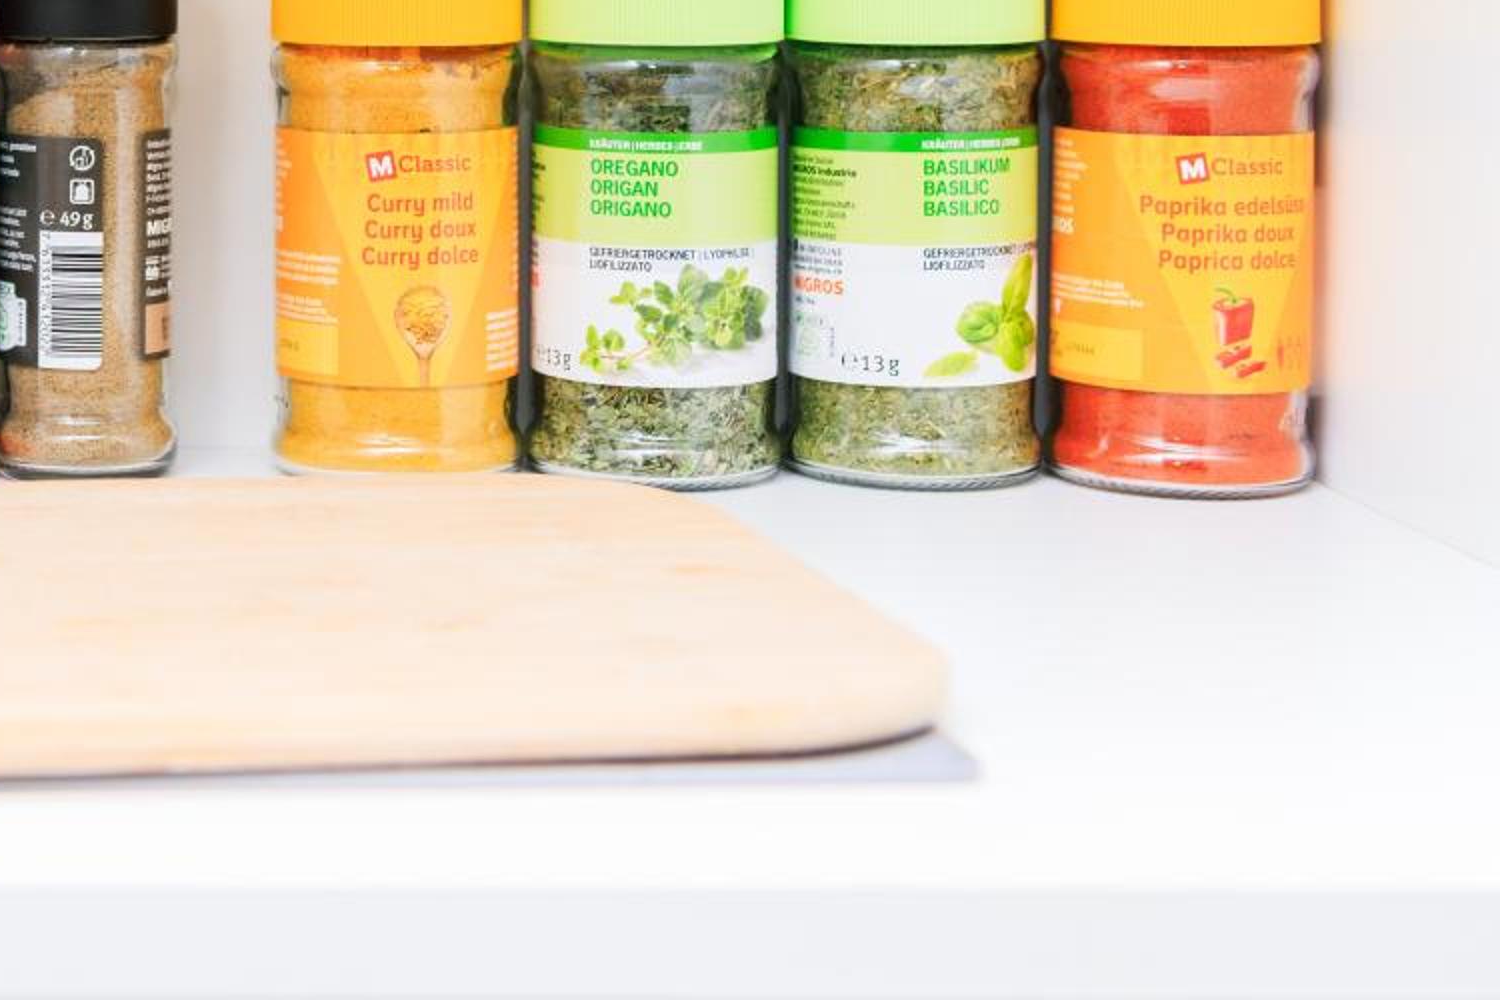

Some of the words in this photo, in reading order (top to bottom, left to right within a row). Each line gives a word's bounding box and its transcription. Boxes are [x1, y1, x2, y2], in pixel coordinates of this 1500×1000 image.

[399, 154, 472, 174] Classic
[590, 159, 679, 177] OREGANO
[923, 157, 1011, 176] BASILIKUM
[1211, 157, 1284, 176] Classic
[590, 179, 659, 197] ORIGAN
[923, 179, 989, 196] BASILIC
[366, 193, 426, 217] Curry
[431, 191, 474, 211] mild
[590, 200, 672, 218] ORIGANO
[923, 199, 1001, 216] BASILICO
[1139, 194, 1227, 219] Paprika
[364, 219, 424, 244] Curry
[430, 219, 477, 239] doux
[1161, 222, 1248, 247] Paprika
[1254, 222, 1295, 243] doux
[362, 246, 421, 271] Curry
[427, 246, 479, 265] dolce
[1158, 249, 1244, 275] Paprica
[1250, 249, 1296, 270] dolce
